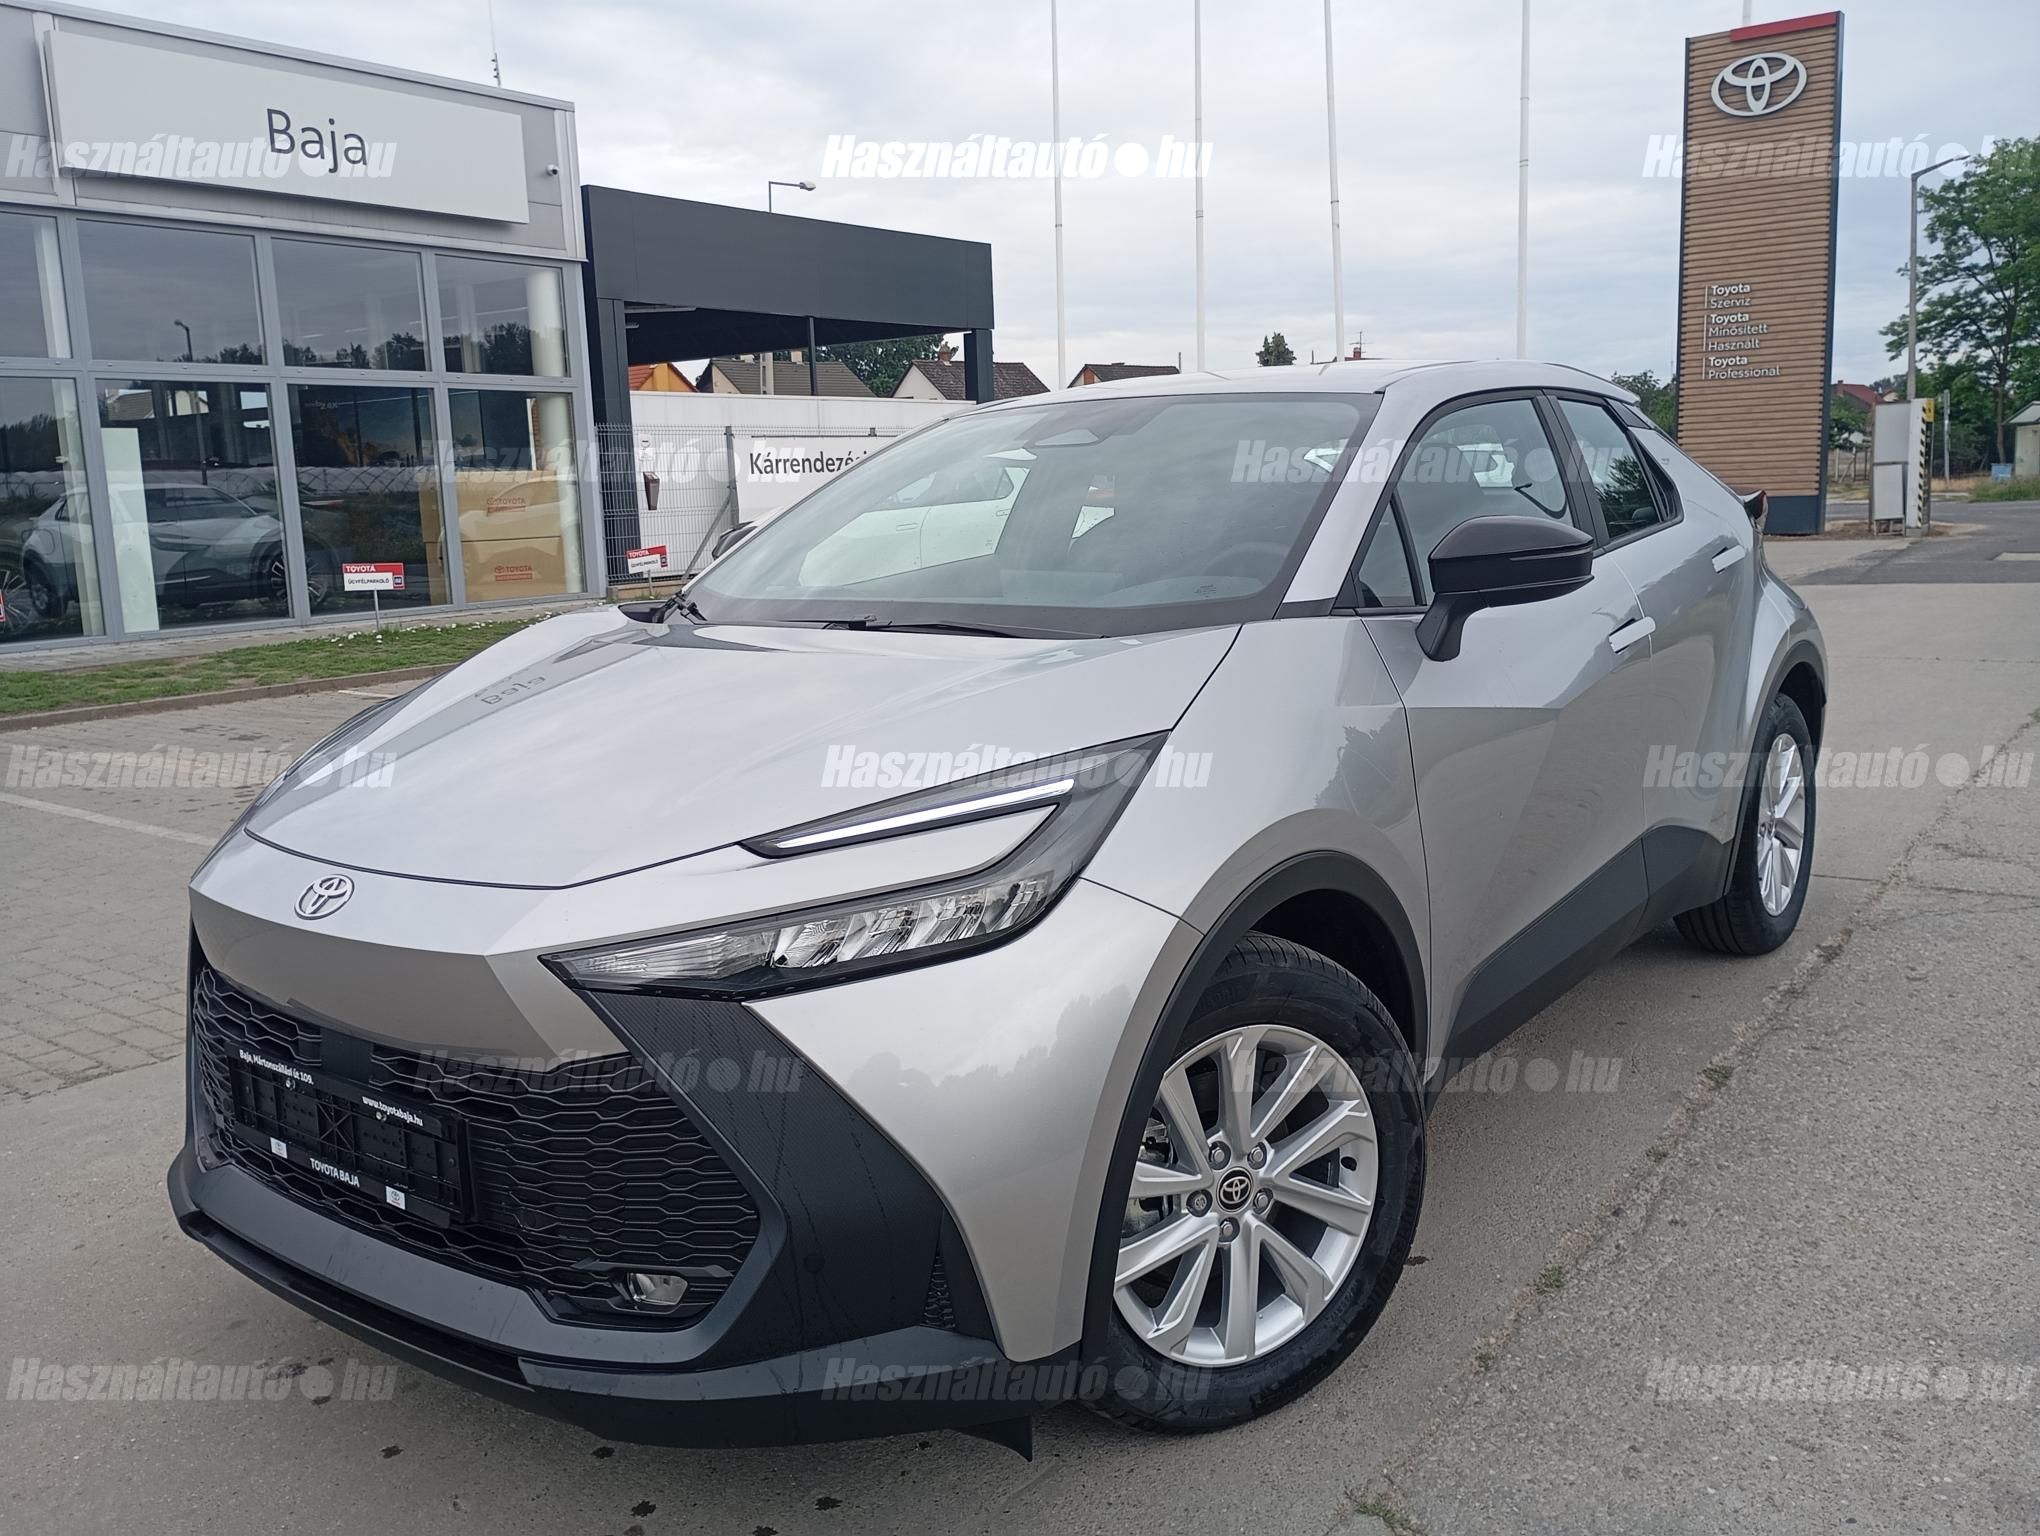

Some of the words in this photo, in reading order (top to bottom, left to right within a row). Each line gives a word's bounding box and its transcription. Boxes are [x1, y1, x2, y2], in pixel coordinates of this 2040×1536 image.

[267, 108, 367, 173] Baja
[1711, 284, 1751, 297] Toyota
[1710, 296, 1751, 309] Szerviz
[1710, 313, 1749, 326] Toyota
[1708, 338, 1760, 352] Használt
[1708, 356, 1748, 369] Toyota
[1708, 364, 1780, 379] Professional
[749, 449, 868, 475] Kárrendezé
[500, 497, 526, 505] TOYOTA
[345, 565, 376, 573] TOYOTA
[505, 565, 533, 573] TOYOTA
[300, 1071, 314, 1086] 109.
[362, 1095, 424, 1127] www.toyotabaja.hu
[310, 1157, 340, 1180] TOYOTA
[339, 1169, 360, 1188] BAJA
